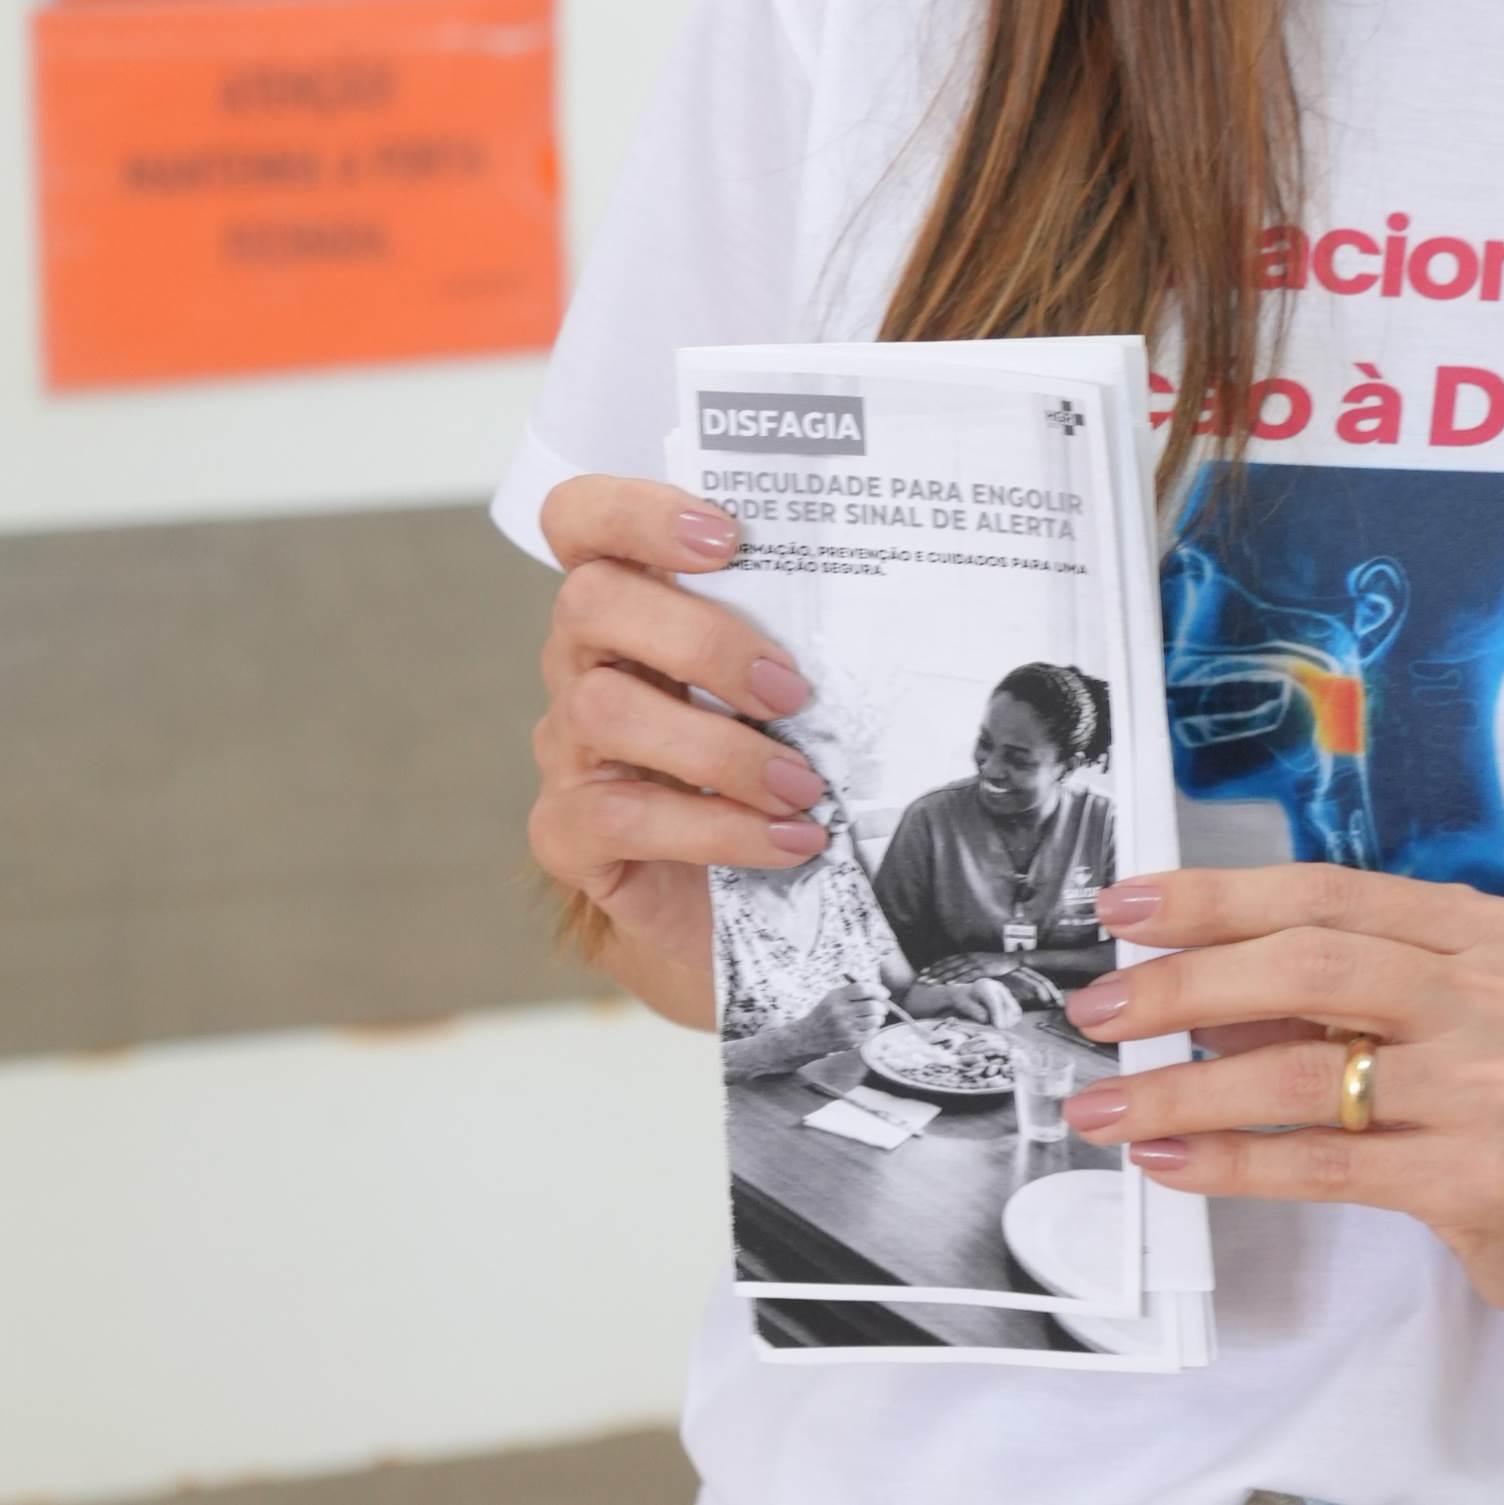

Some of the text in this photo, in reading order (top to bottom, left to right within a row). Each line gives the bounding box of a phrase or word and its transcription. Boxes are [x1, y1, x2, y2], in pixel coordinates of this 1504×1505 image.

[702, 407, 863, 441] DISFAGIA
[1335, 362, 1404, 445] à
[702, 470, 1084, 515] DIFICULDADE PARA ENGOLIR
[786, 500, 837, 524] SER
[844, 502, 925, 528] SINAL
[931, 508, 967, 531] DE
[976, 511, 1076, 541] ALERTA
[914, 551, 925, 562] E
[926, 552, 1008, 568] CUIDADOS
[1010, 557, 1051, 571] PARA
